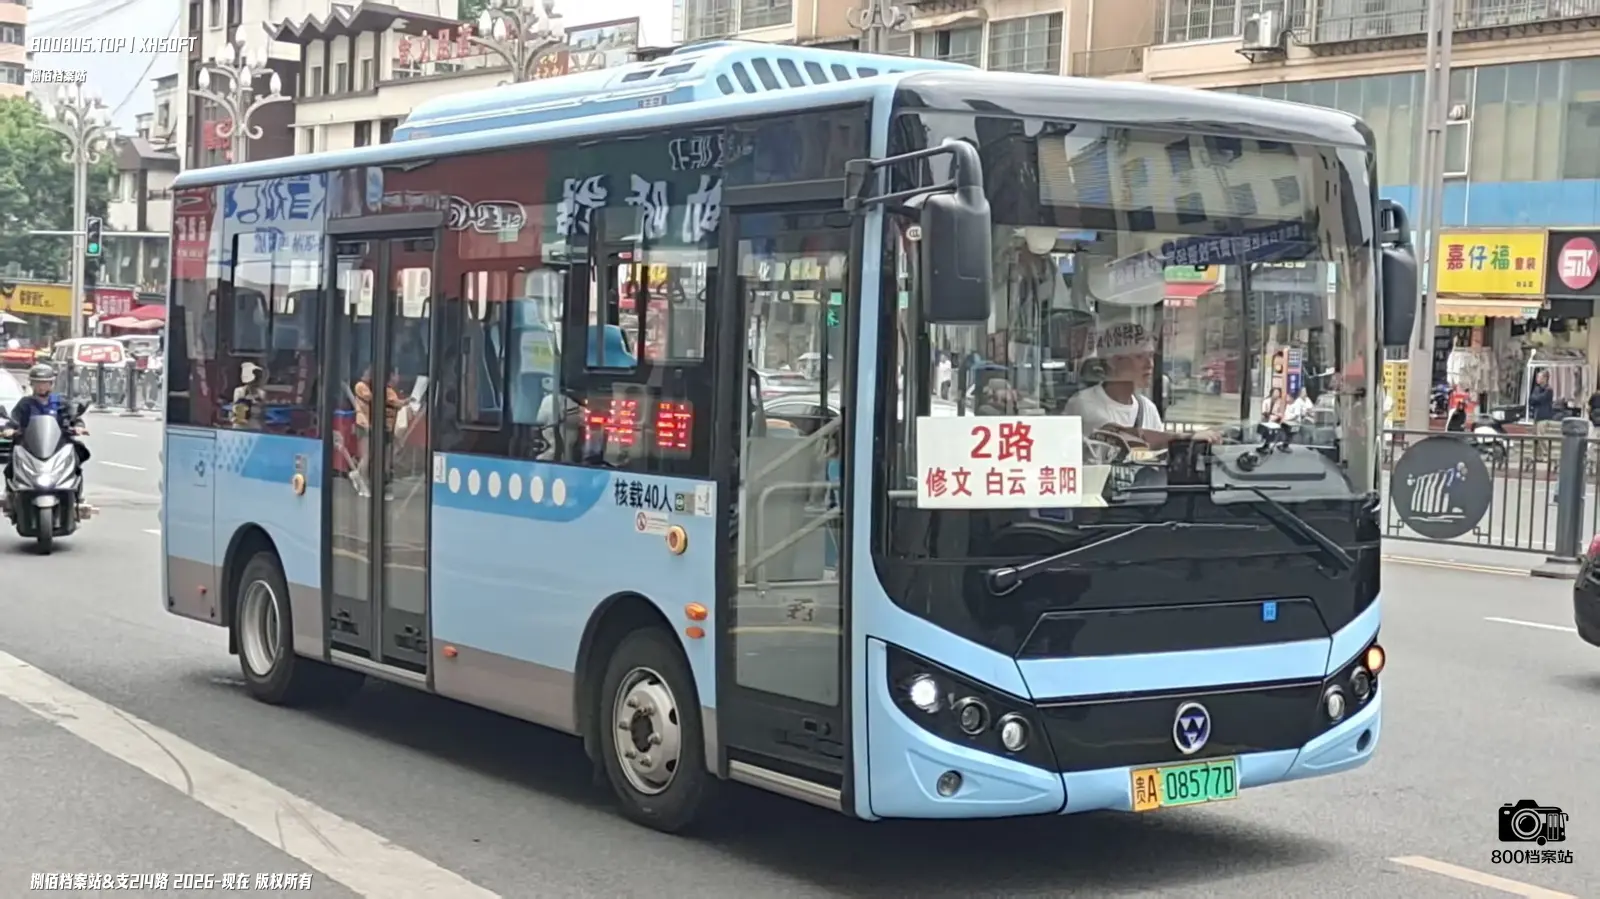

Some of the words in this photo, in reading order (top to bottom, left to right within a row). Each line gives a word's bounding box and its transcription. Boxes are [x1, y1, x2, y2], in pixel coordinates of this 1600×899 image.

[1446, 244, 1511, 271] 嘉仔福
[970, 421, 1035, 463] 2路
[614, 478, 673, 513] 核载40人
[925, 466, 973, 498] 修文
[985, 466, 1027, 496] 白云
[1037, 465, 1078, 496] 贵阳
